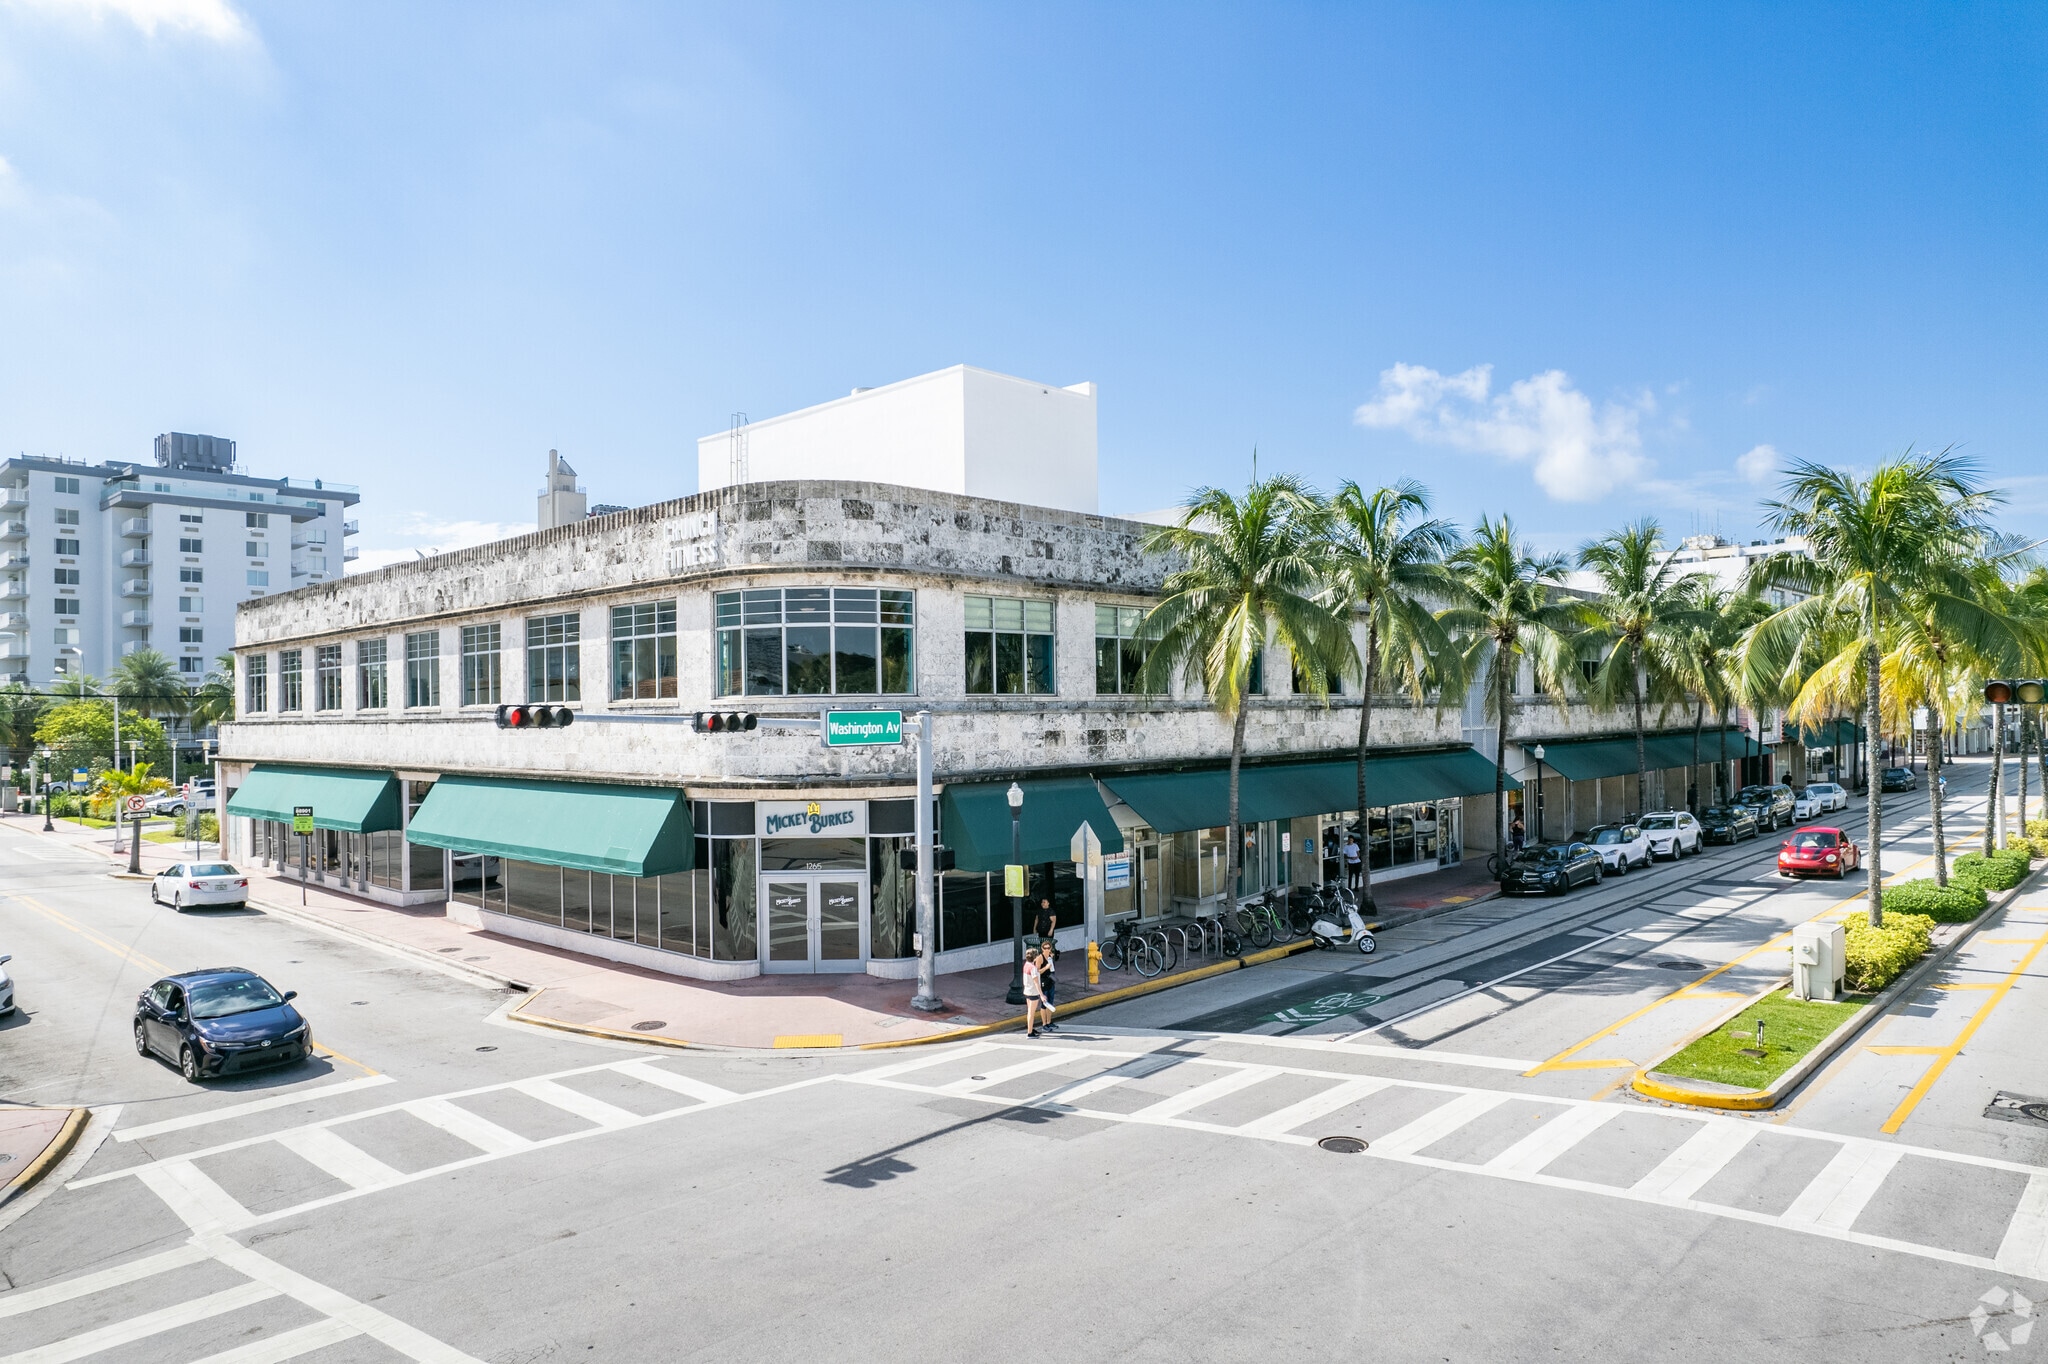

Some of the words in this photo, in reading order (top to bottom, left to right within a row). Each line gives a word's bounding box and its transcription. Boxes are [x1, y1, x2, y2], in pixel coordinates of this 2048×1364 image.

[664, 511, 717, 542] CRUNCH
[663, 540, 719, 572] FITNESS
[829, 722, 883, 738] Washington
[886, 721, 900, 734] Av
[808, 810, 854, 834] BURKES
[806, 862, 822, 870] 1265
